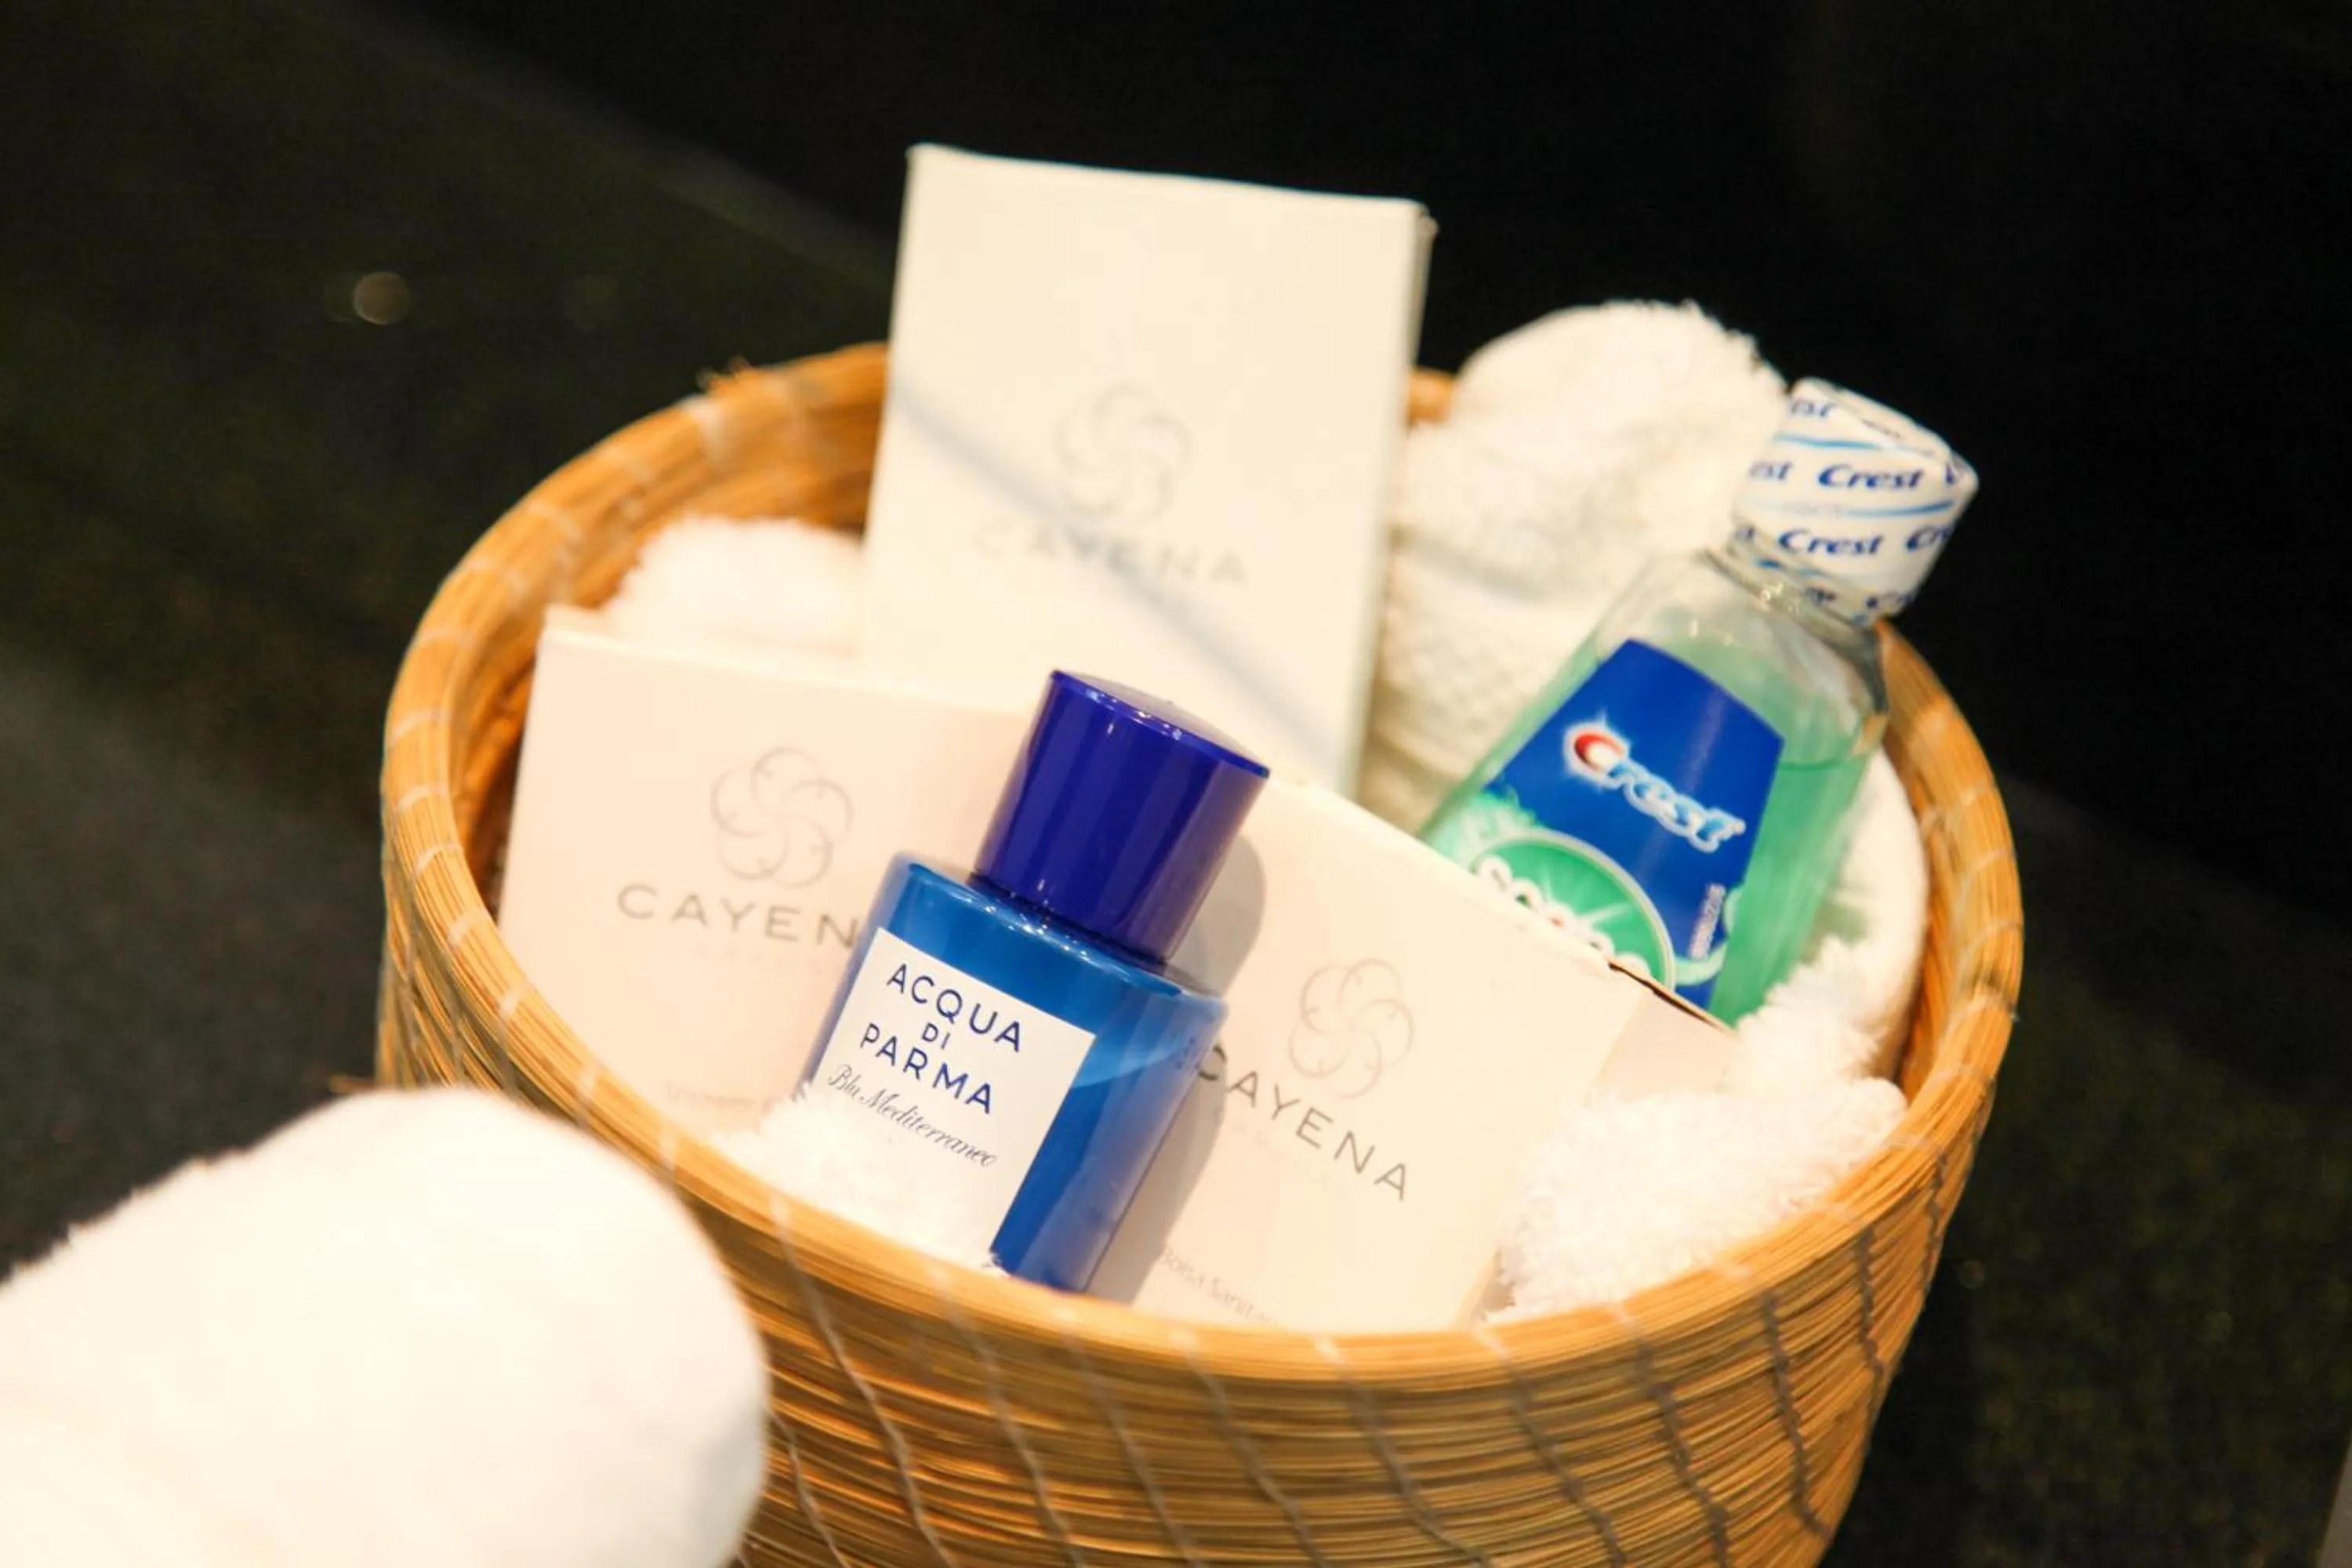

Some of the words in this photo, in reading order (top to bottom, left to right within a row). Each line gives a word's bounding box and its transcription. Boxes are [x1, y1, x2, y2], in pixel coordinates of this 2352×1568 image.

[1749, 460, 1792, 481] est
[1819, 464, 1924, 488] Crest
[972, 519, 1248, 585] CAYENA
[1779, 528, 1884, 554] Crest
[1565, 721, 1746, 853] Crest
[617, 882, 861, 950] CAYEN
[887, 964, 1022, 1052] ACQUA
[922, 1022, 951, 1049] DI
[860, 1023, 992, 1114] PARMA
[828, 1064, 861, 1098] Blu
[859, 1089, 998, 1167] Mediterraneo
